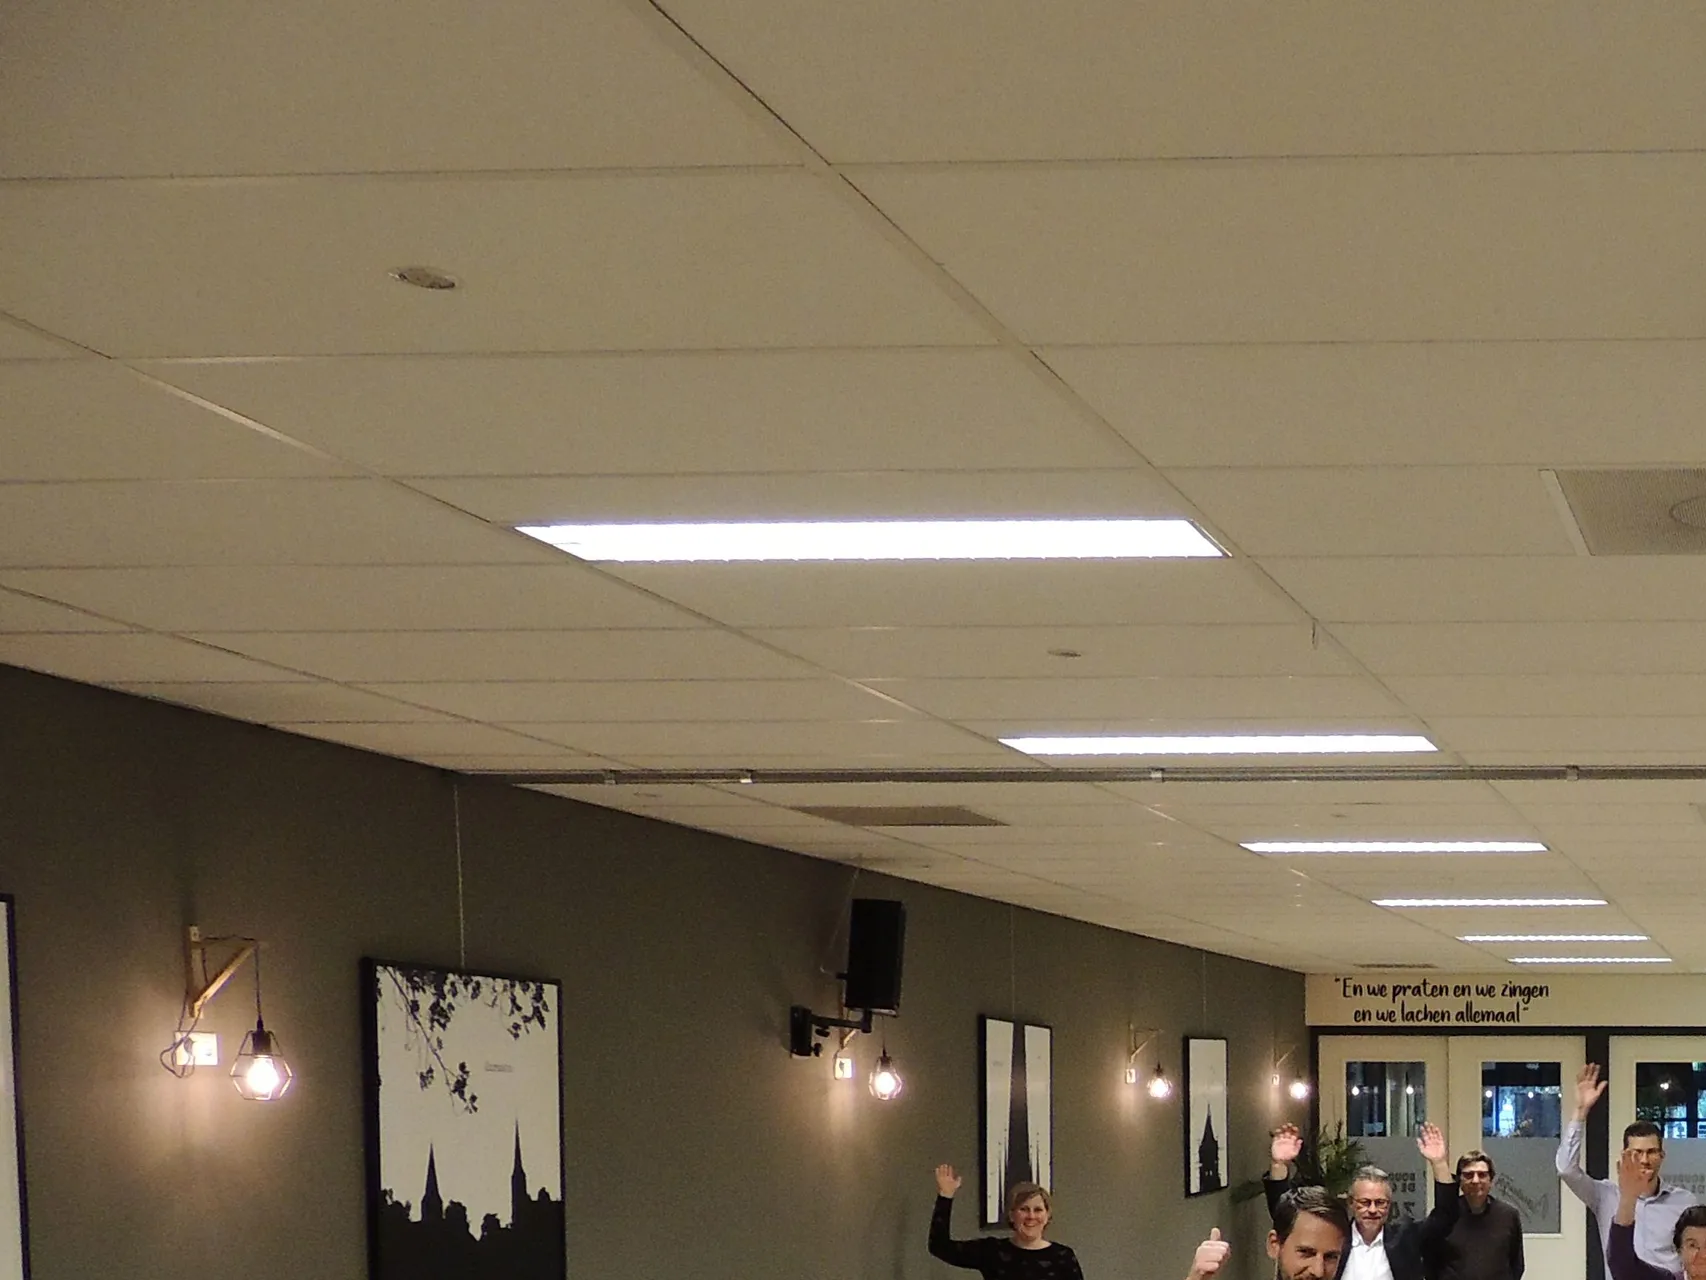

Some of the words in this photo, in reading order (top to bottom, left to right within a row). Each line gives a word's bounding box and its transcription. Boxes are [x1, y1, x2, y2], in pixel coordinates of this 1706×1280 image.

[1366, 983, 1388, 997] we
[1392, 978, 1449, 1003] praten
[1453, 983, 1471, 997] en
[1475, 983, 1496, 997] we
[1501, 980, 1549, 1004] zingen
[1353, 1009, 1372, 1022] en
[1376, 1009, 1396, 1022] we
[1401, 1000, 1450, 1022] lachen
